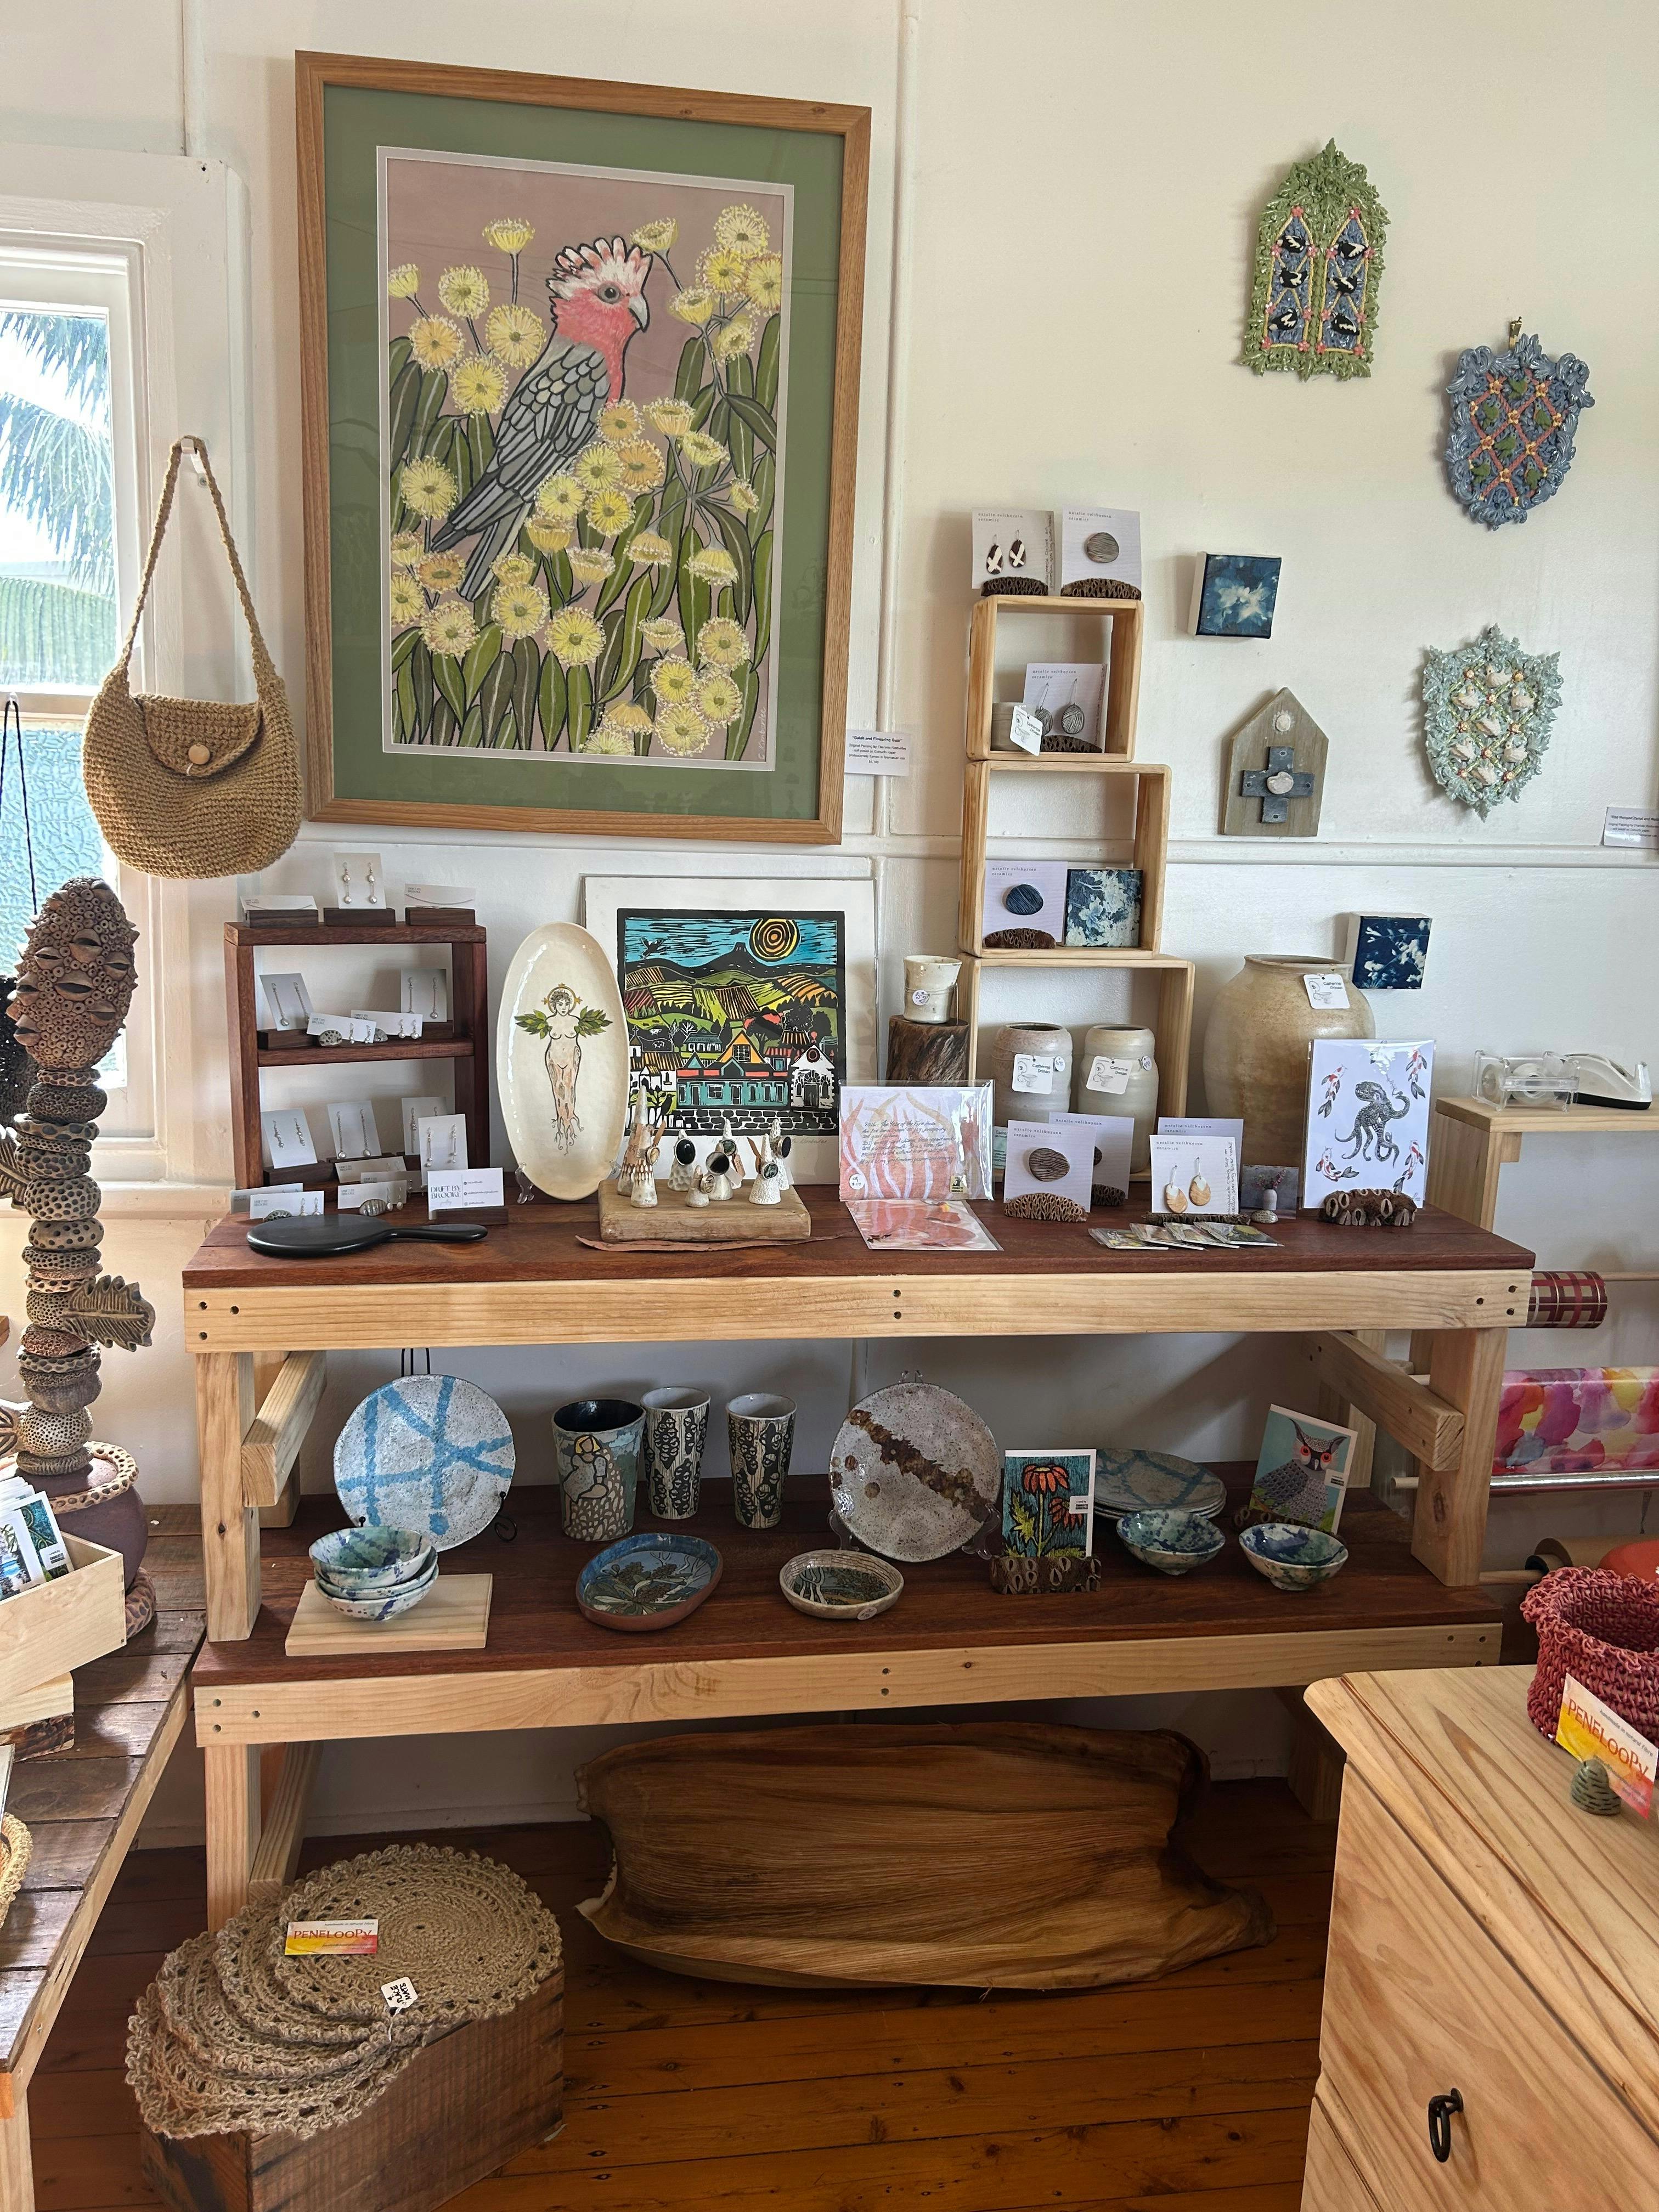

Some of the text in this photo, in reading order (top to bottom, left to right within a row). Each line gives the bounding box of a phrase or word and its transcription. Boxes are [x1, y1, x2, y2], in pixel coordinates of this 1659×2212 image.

[1567, 1698, 1649, 1781] PENELOOPY
[1599, 1708, 1620, 1729] handmade
[1626, 1731, 1641, 1746] natural
[294, 1928, 373, 1939] PENELOOPY
[399, 1982, 413, 2000] MATS
